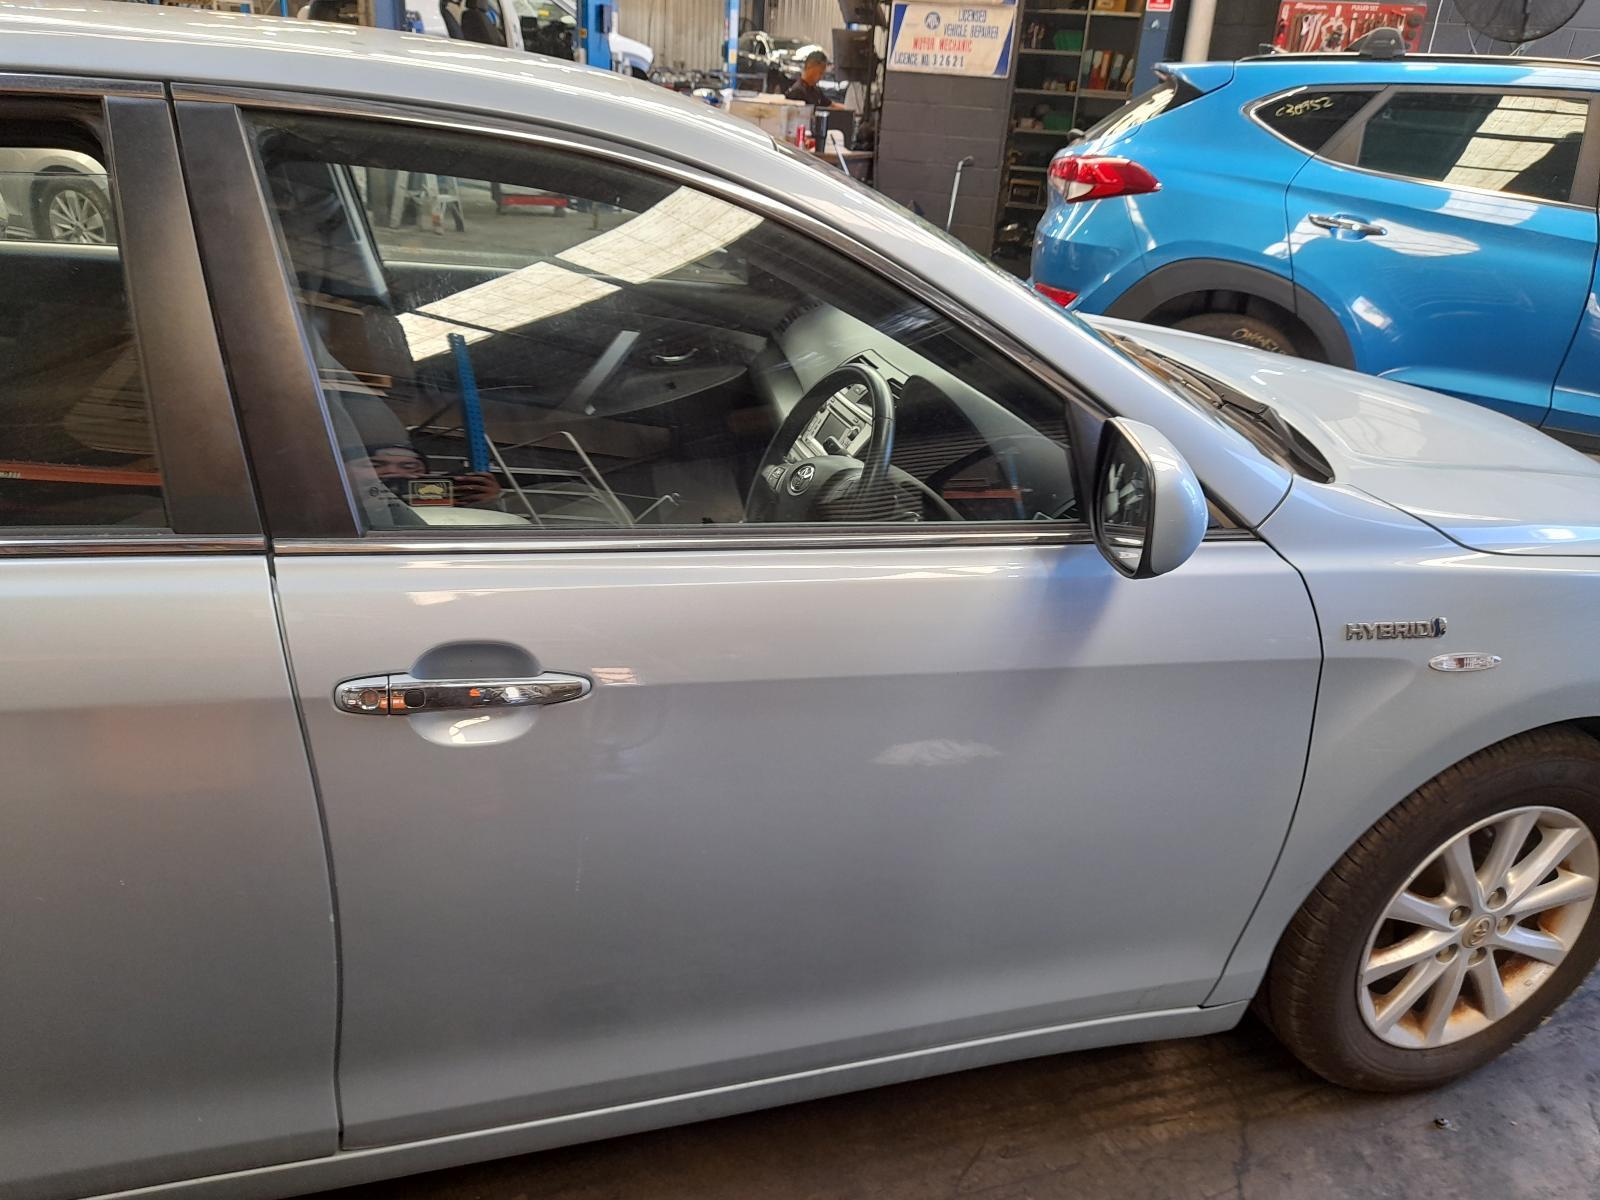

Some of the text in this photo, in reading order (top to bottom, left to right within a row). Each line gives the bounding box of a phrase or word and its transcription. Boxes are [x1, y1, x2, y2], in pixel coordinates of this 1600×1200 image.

[958, 8, 987, 23] LICENSED
[944, 23, 999, 40] VEHICLE REPAIRER
[912, 37, 973, 52] MOTOR MECHANIC
[894, 52, 918, 66] LICENCE
[1346, 622, 1432, 640] HYBRID
